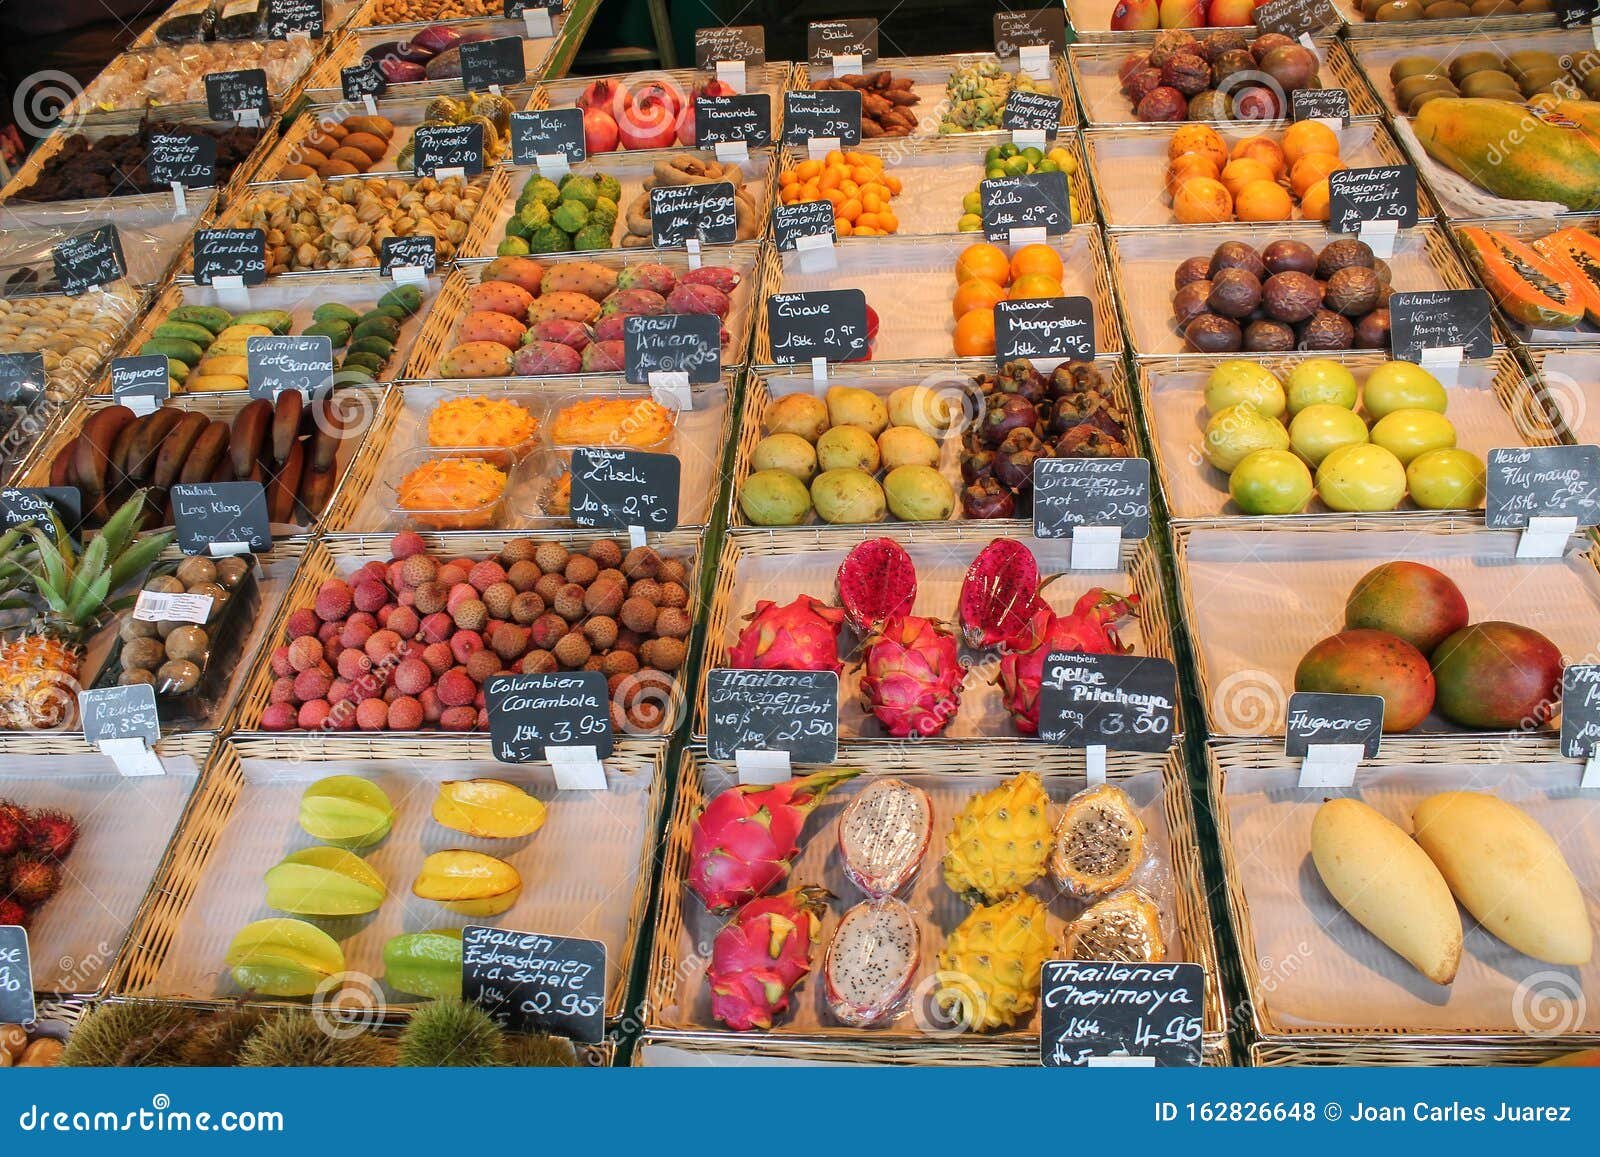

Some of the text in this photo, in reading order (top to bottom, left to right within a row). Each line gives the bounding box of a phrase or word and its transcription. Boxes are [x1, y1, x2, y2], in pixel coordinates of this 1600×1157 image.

[1010, 92, 1061, 109] Thailand
[702, 107, 758, 119] Tamarinde
[416, 125, 471, 137] Columbien
[983, 178, 1021, 189] Thailand
[1331, 169, 1401, 185] Columbien
[988, 190, 1023, 206] Lulo
[1353, 188, 1400, 204] frucht
[1046, 213, 1059, 225] €
[199, 230, 256, 240] Thailand
[203, 240, 259, 255] Curuba
[772, 293, 805, 303] Brasil
[1399, 293, 1451, 306] Kolumbien
[778, 302, 831, 318] Guave
[998, 301, 1054, 312] Thailand
[628, 315, 679, 334] Brasil
[1009, 316, 1087, 337] Mangosteen
[850, 338, 865, 349] €
[1077, 344, 1091, 354] €
[279, 360, 332, 372] Banane
[113, 366, 166, 385] Flugware
[576, 448, 626, 461] Thailand
[1494, 449, 1532, 465] Mexico
[583, 459, 647, 484] Litschi
[1039, 459, 1124, 474] Thailand
[175, 485, 217, 497] Thailand
[181, 502, 207, 521] Long
[649, 508, 668, 523] €
[250, 536, 264, 548] €
[1047, 653, 1099, 665] Kolumbien
[490, 674, 585, 695] Columbien
[721, 670, 818, 689] Thailand
[1041, 665, 1108, 691] gelbe
[501, 693, 600, 712] Carambola
[1070, 684, 1173, 715] Pitahaya
[549, 715, 609, 743] 3.95
[776, 718, 835, 742] 2.50
[1099, 712, 1169, 735] 3.50
[1288, 709, 1373, 737] Flugware
[464, 929, 554, 953] Italien
[1048, 963, 1180, 983] Thailand
[521, 991, 604, 1017] 2.95
[1134, 1016, 1203, 1048] 4.95
